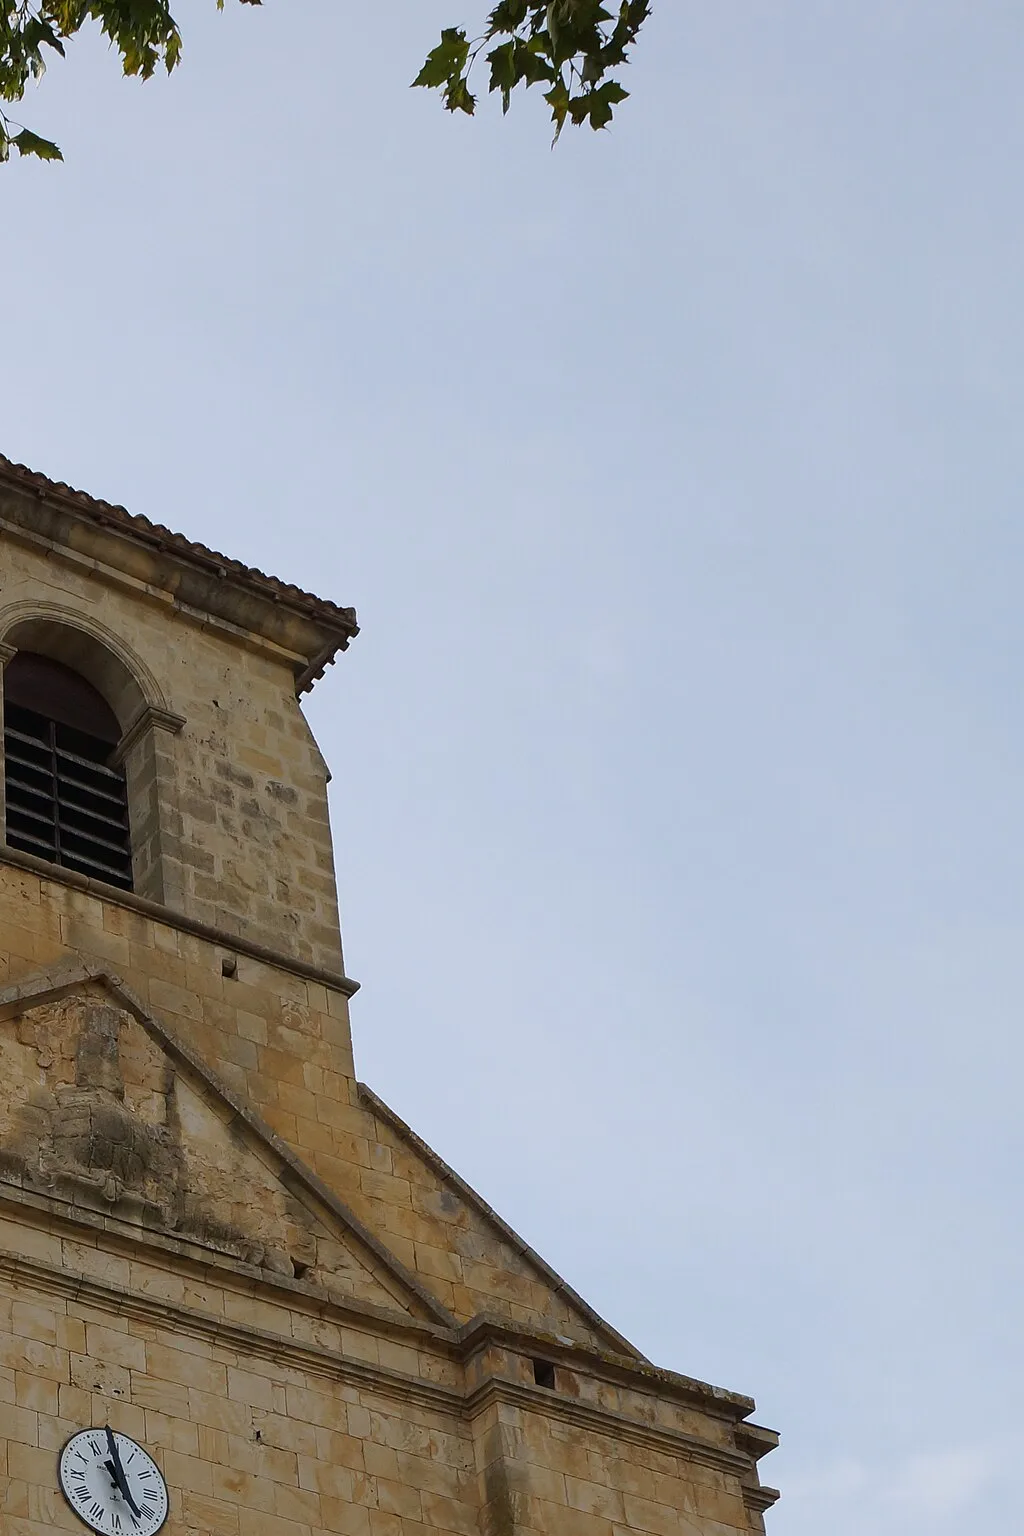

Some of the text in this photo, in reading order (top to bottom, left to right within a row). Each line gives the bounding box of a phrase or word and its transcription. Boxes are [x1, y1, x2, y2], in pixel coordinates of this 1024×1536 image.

[87, 1440, 102, 1457] XI
[74, 1450, 90, 1465] X
[137, 1470, 152, 1480] II
[142, 1488, 158, 1502] III
